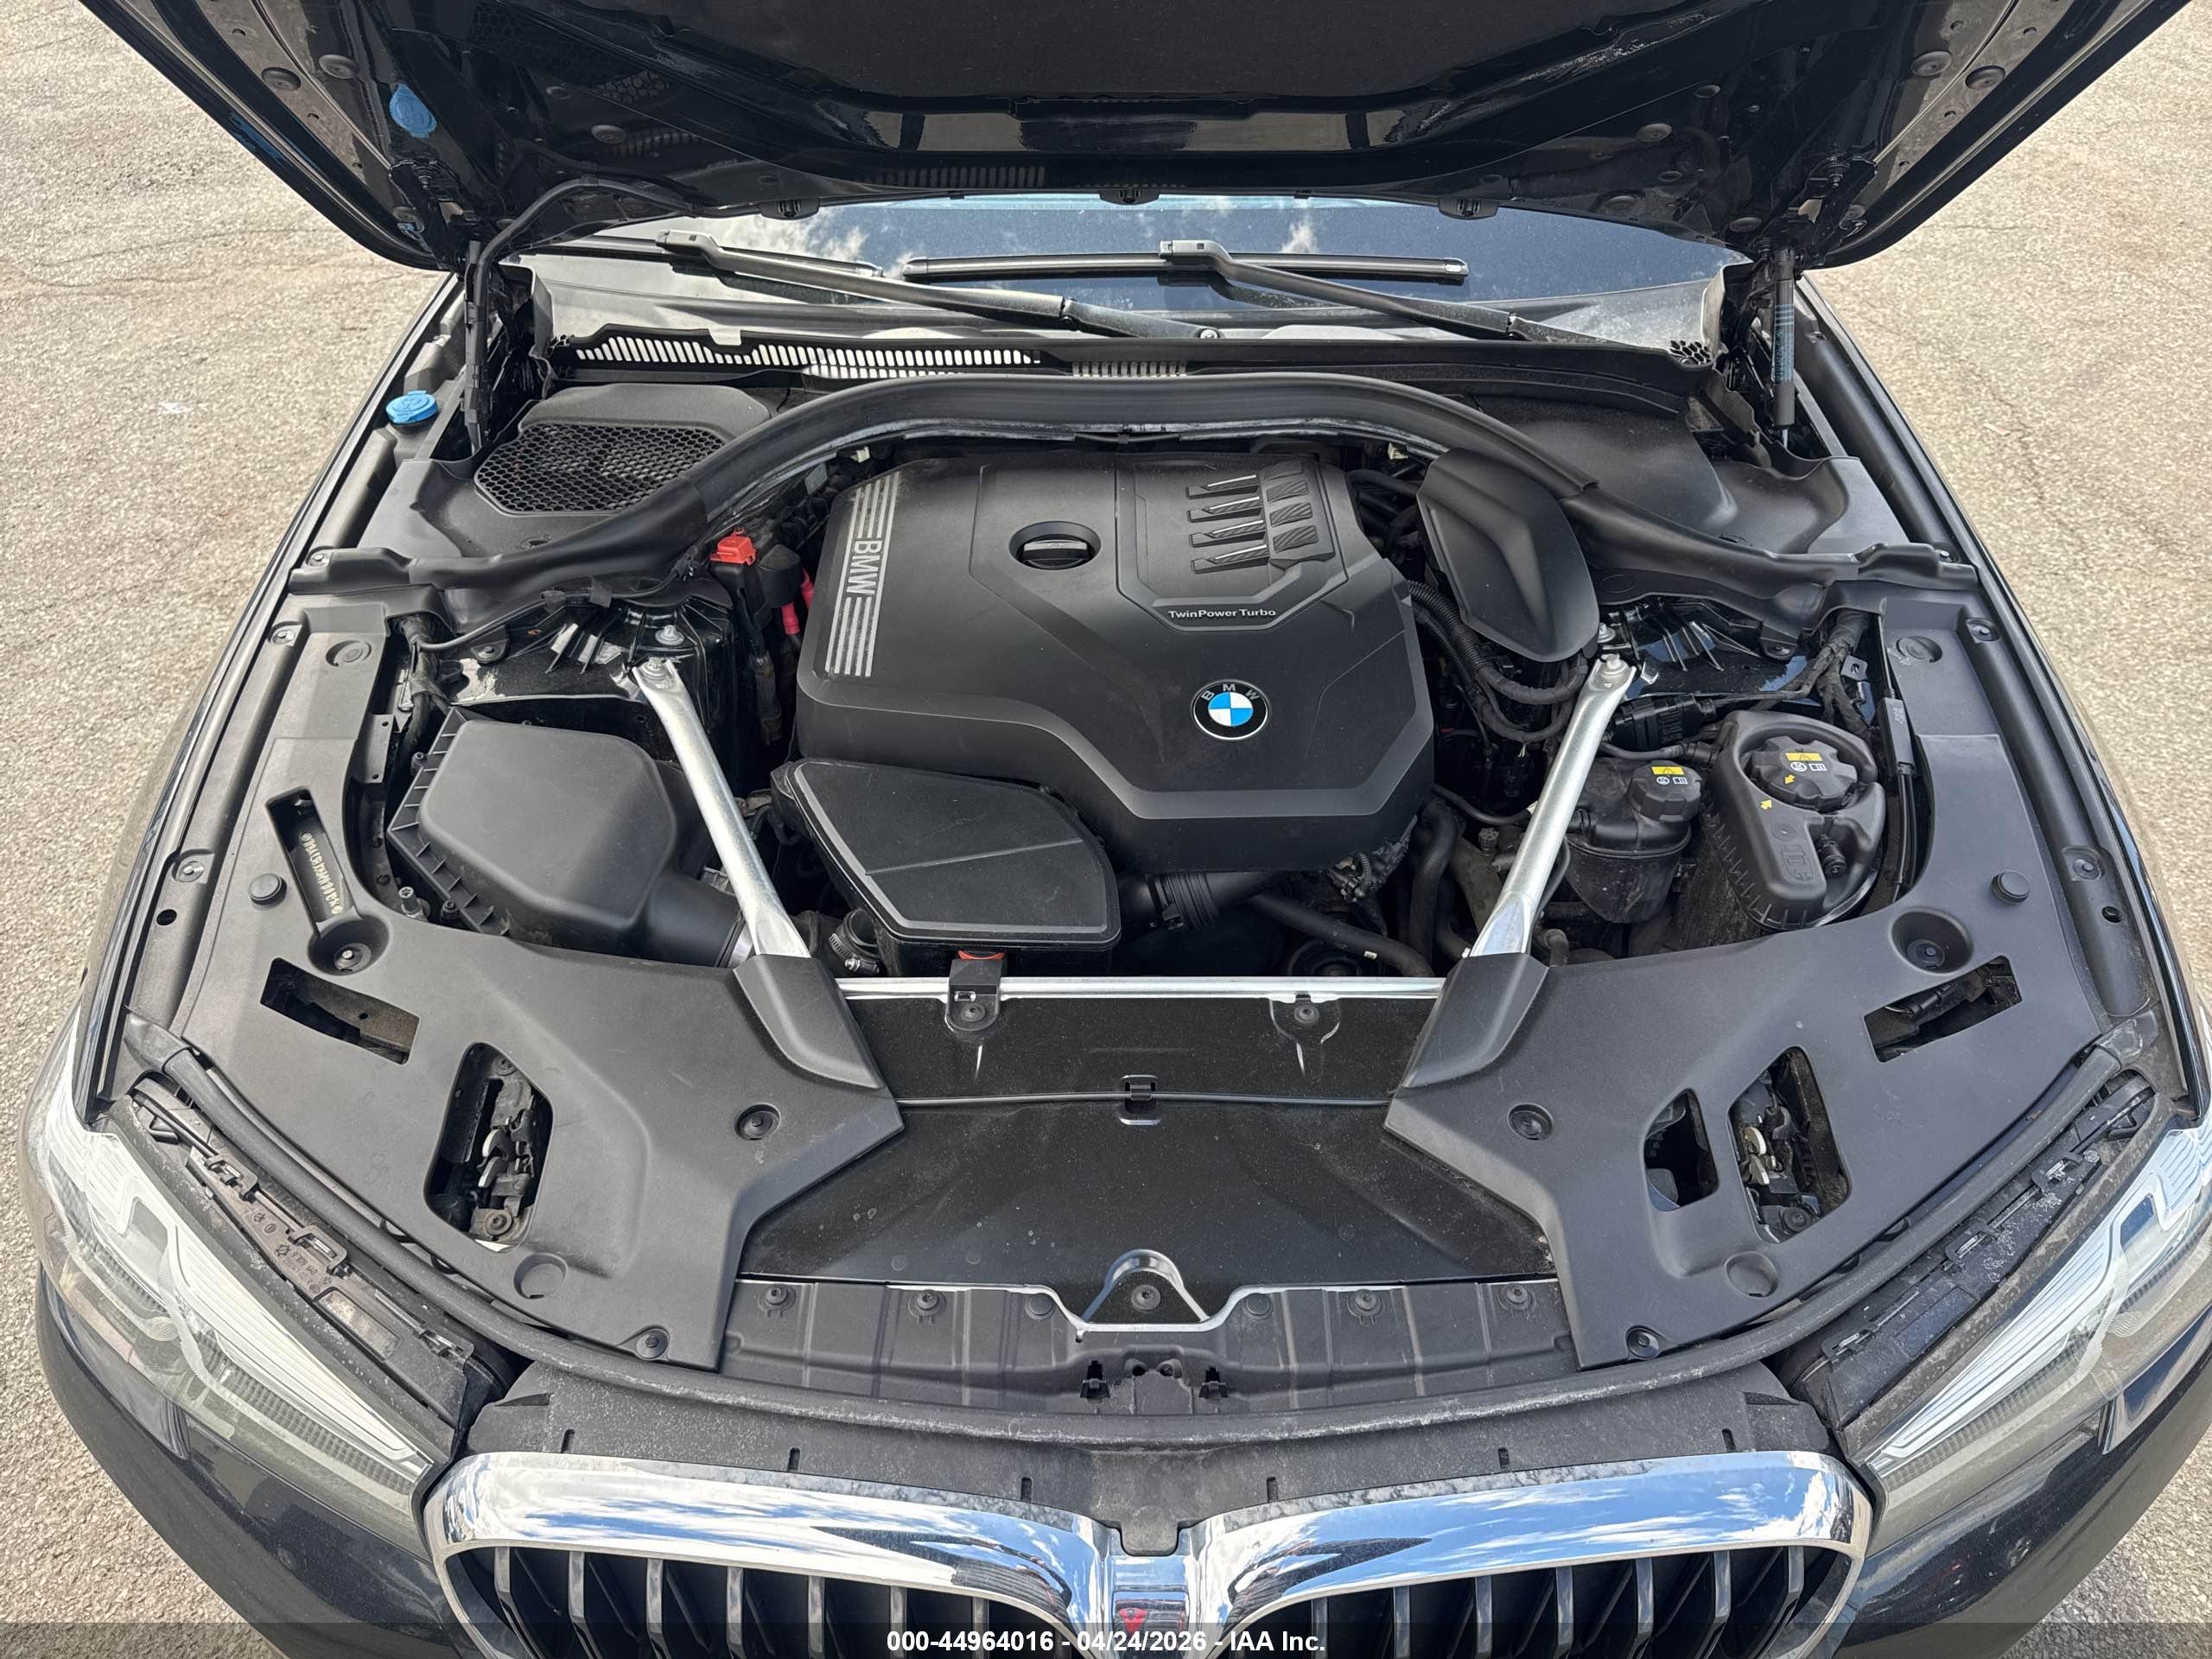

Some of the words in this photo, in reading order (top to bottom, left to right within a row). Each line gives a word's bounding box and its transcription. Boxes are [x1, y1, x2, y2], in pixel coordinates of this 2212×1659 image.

[846, 540, 882, 595] BMW
[1168, 609, 1237, 618] TwinPower
[1201, 683, 1260, 701] BMW
